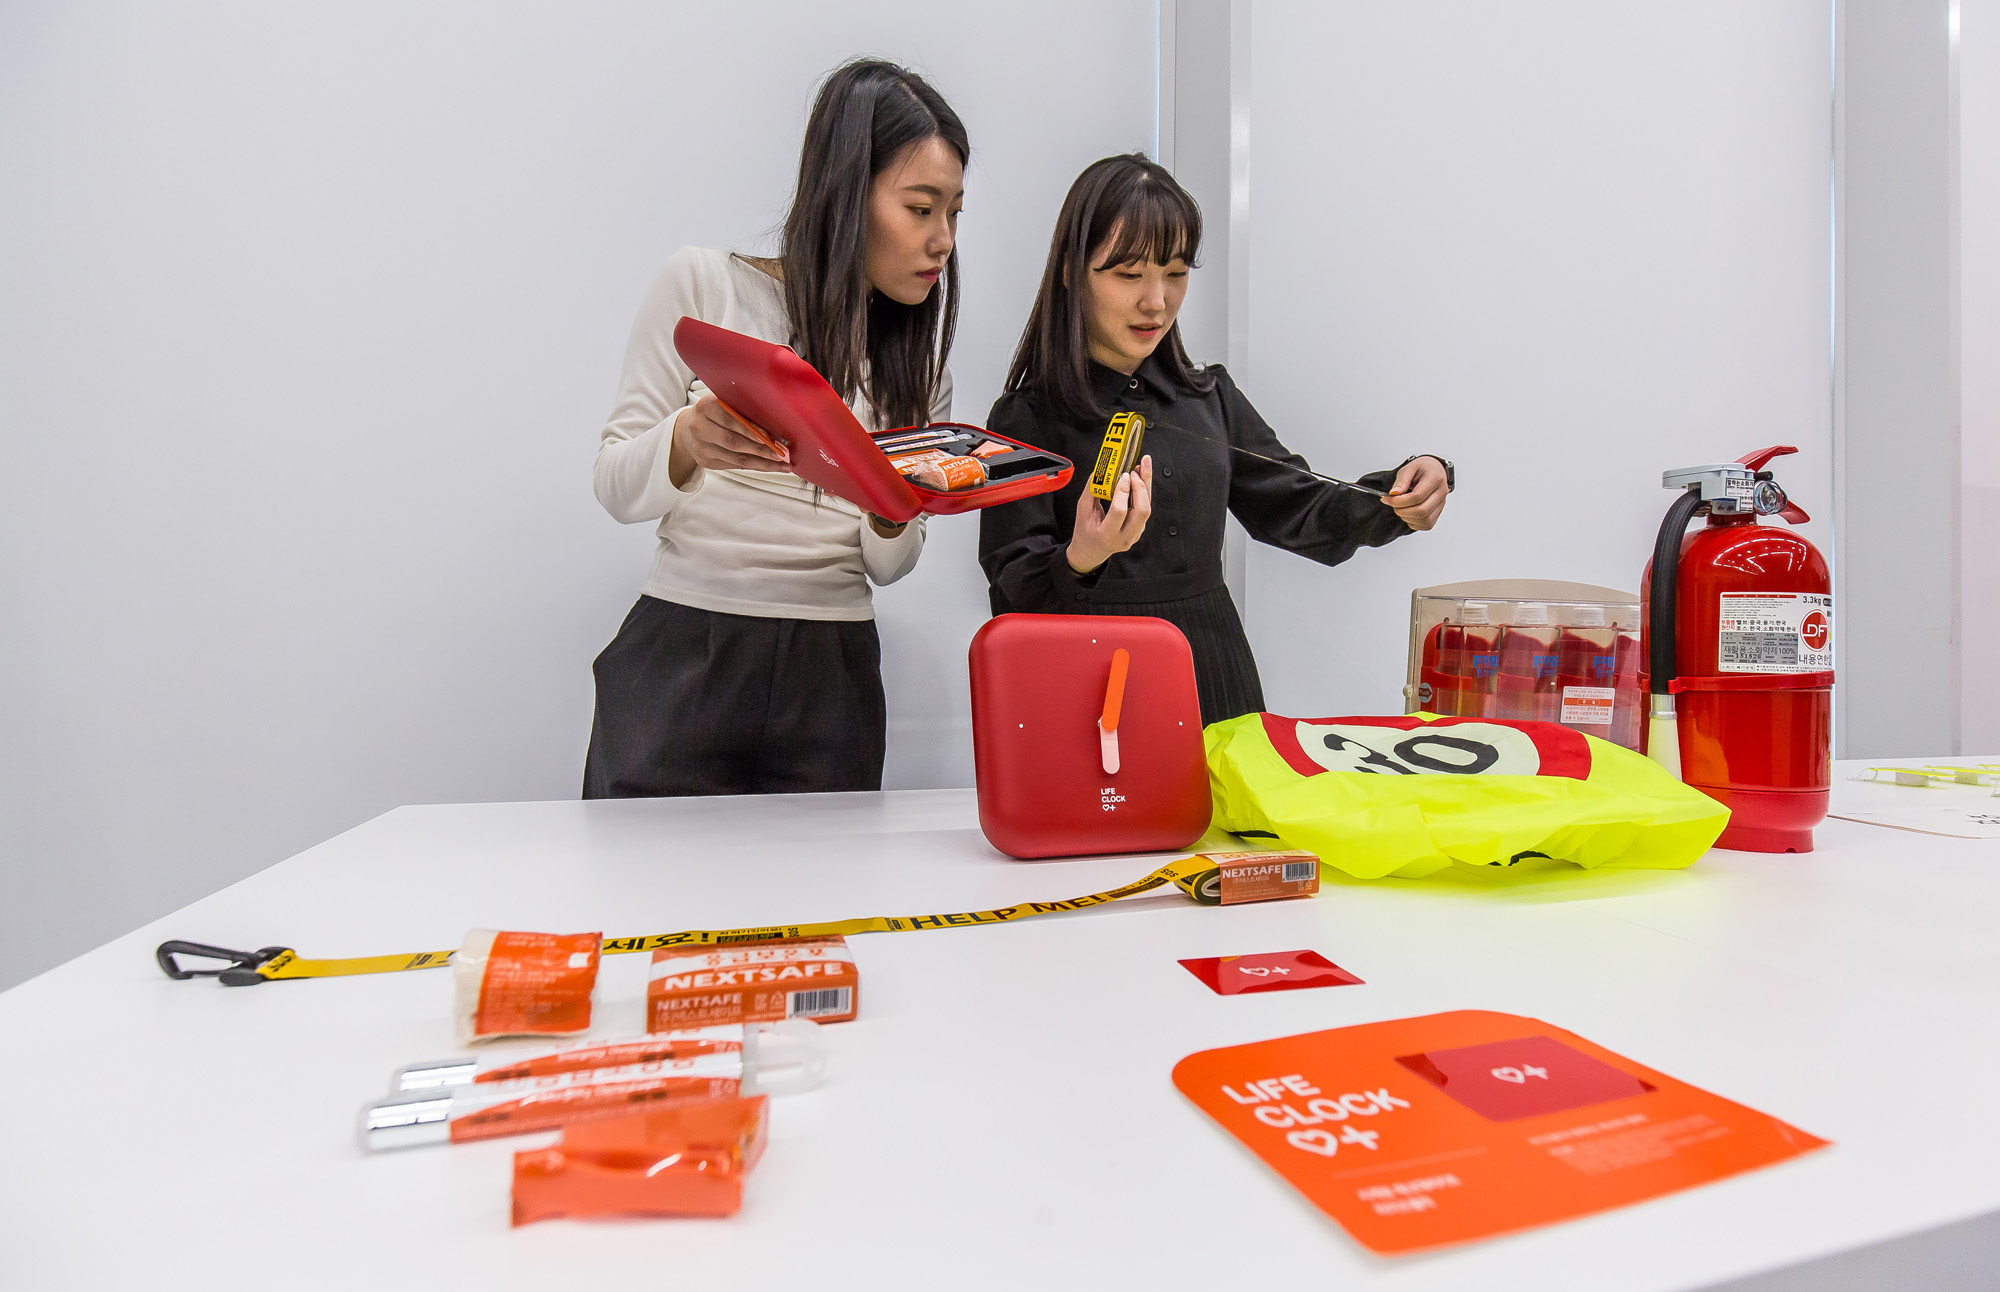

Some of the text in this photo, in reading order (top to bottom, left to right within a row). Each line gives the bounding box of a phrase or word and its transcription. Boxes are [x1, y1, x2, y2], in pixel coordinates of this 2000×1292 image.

[1093, 487, 1107, 496] SOS
[1803, 596, 1821, 605] 3.3kg
[1778, 647, 1796, 655] 100%
[1100, 787, 1116, 795] LIFE
[1101, 795, 1126, 803] CLOCK
[1160, 868, 1179, 879] SOS
[1222, 865, 1281, 879] NEXTSAFE
[911, 909, 1018, 930] HELP
[1028, 892, 1108, 914] ME!
[664, 962, 844, 990] NEXTSAFE
[656, 992, 743, 1011] NEXTSAFE
[1221, 1074, 1321, 1106] LIFE
[1254, 1087, 1411, 1129] CLOCK
